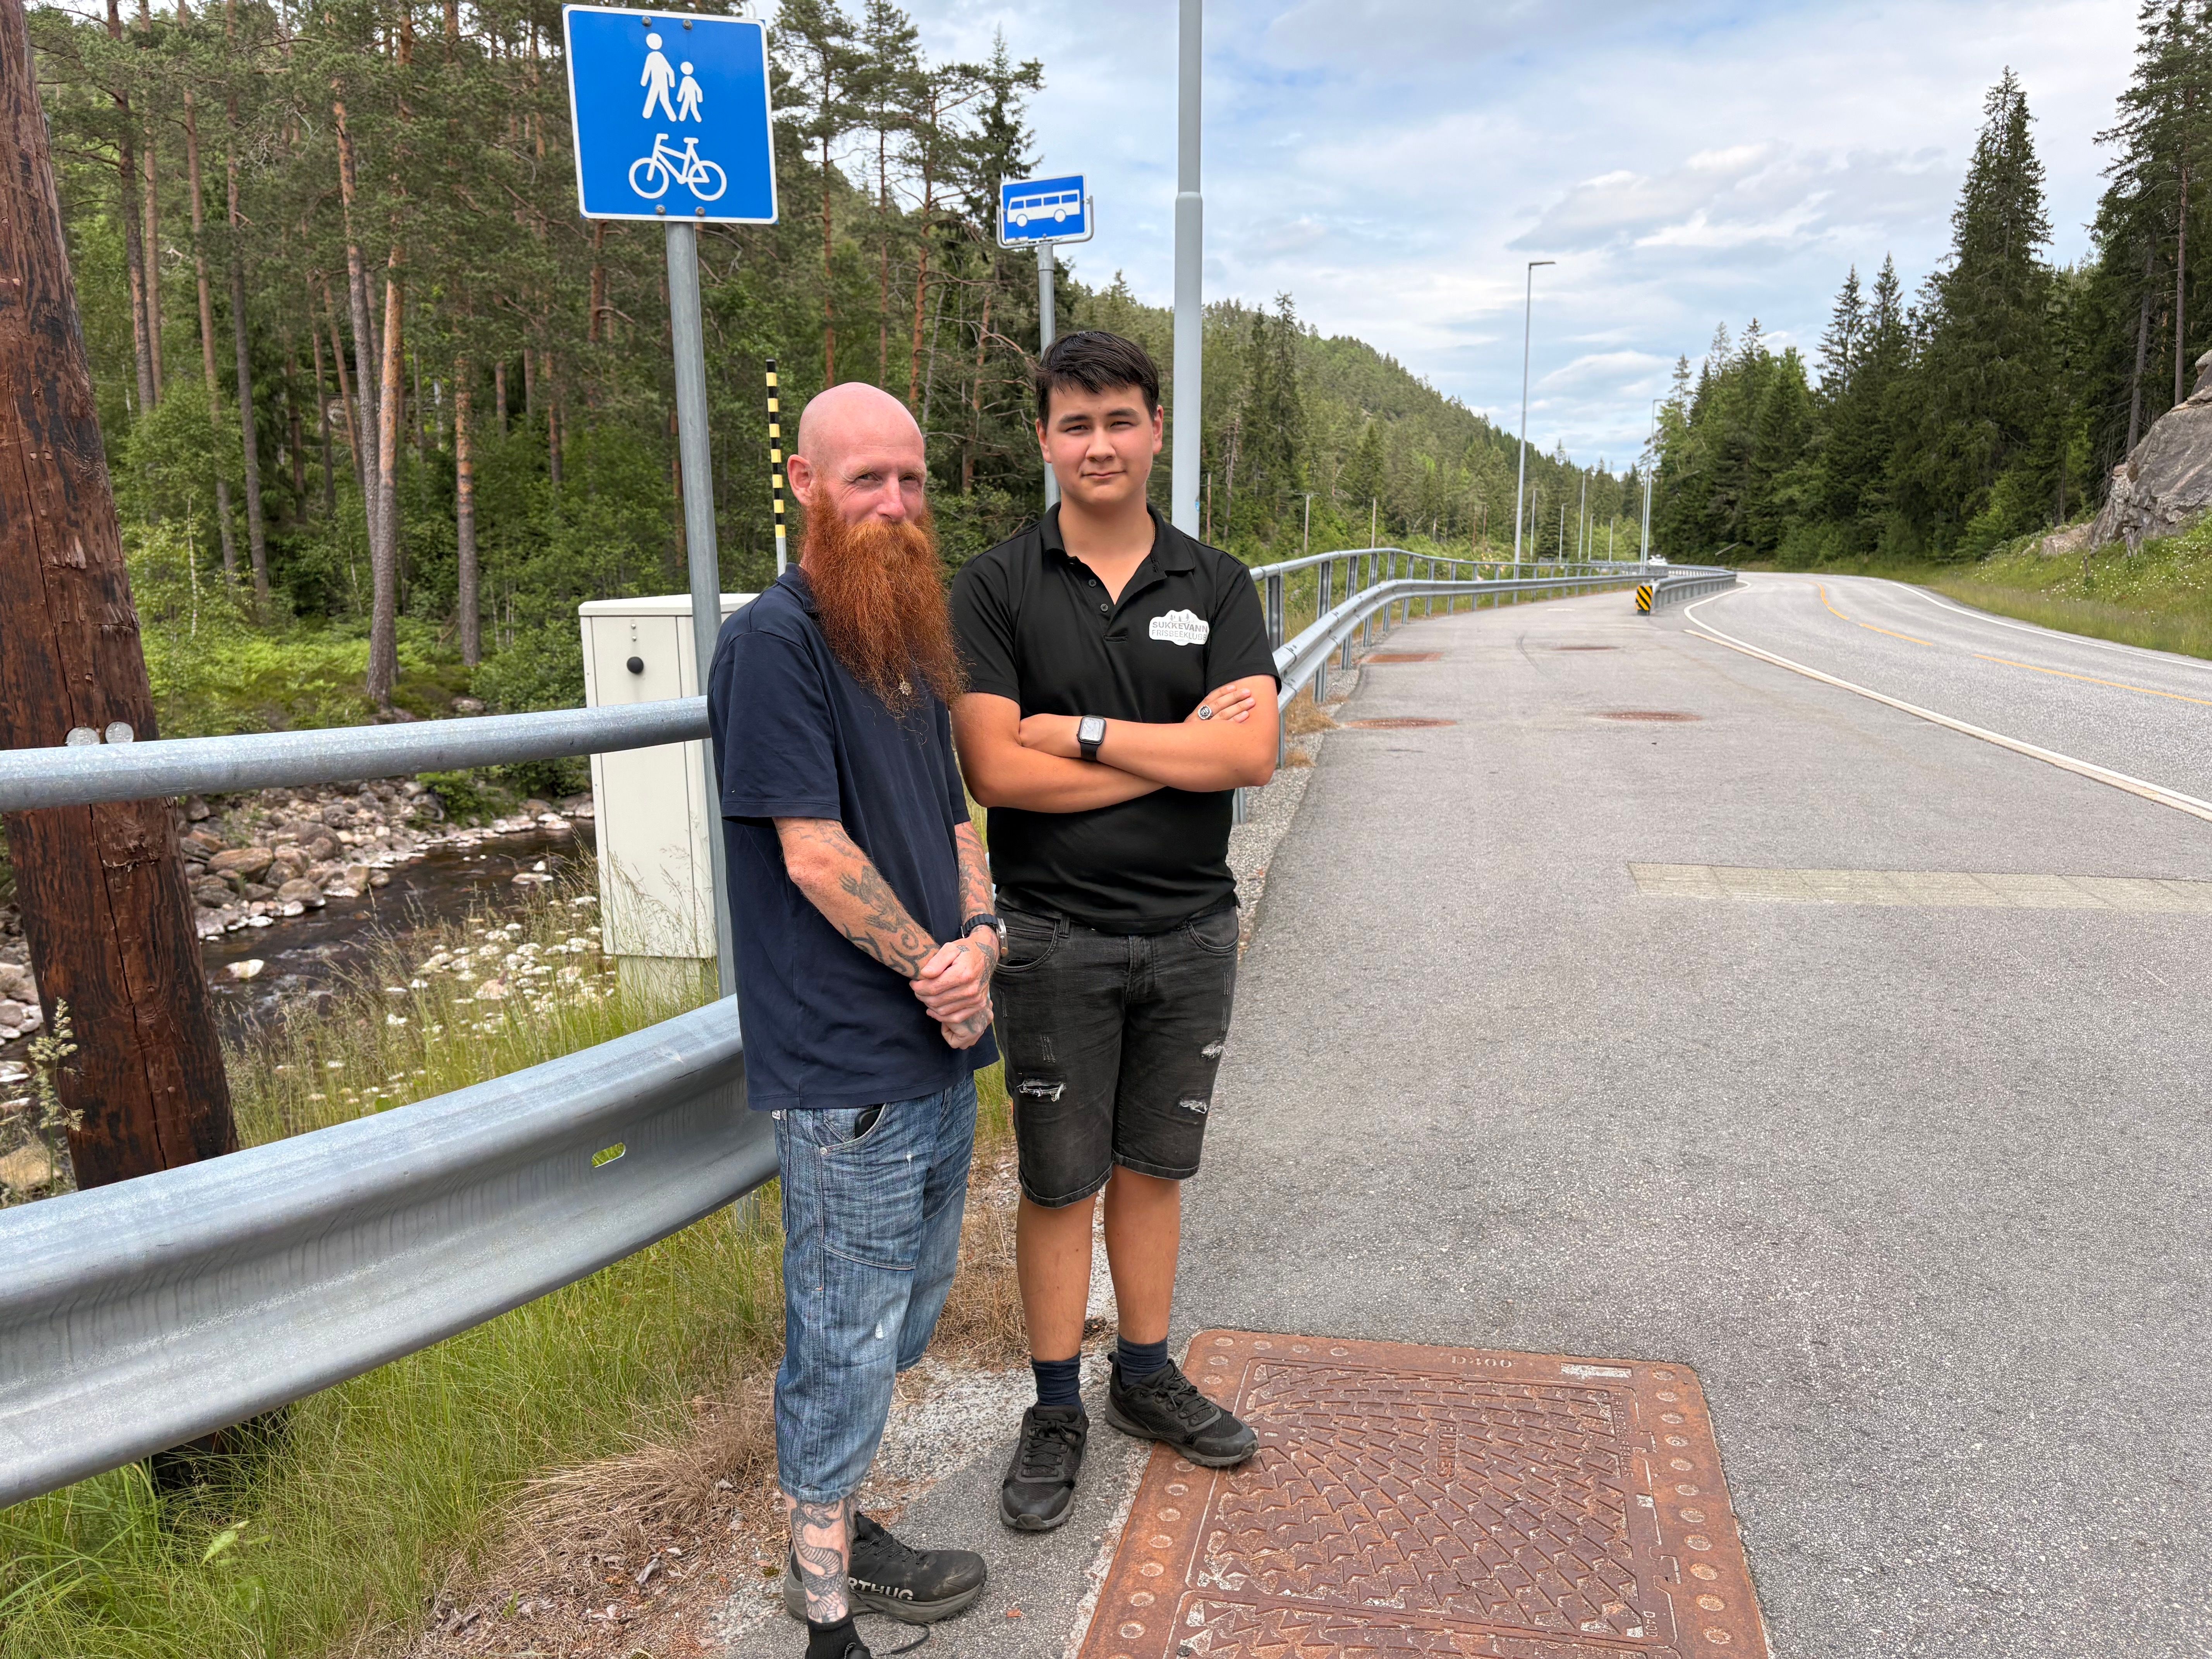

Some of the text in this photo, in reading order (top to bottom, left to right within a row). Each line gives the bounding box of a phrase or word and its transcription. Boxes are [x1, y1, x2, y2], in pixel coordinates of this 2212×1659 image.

[1152, 622, 1207, 633] SUKKEVANN
[1152, 630, 1207, 641] FRISBEEKLUBB
[1437, 1424, 1457, 1478] FURNES
[1618, 1439, 1633, 1477] REGULAR
[848, 1577, 913, 1600] RTHUG
[1644, 1611, 1658, 1637] D400
